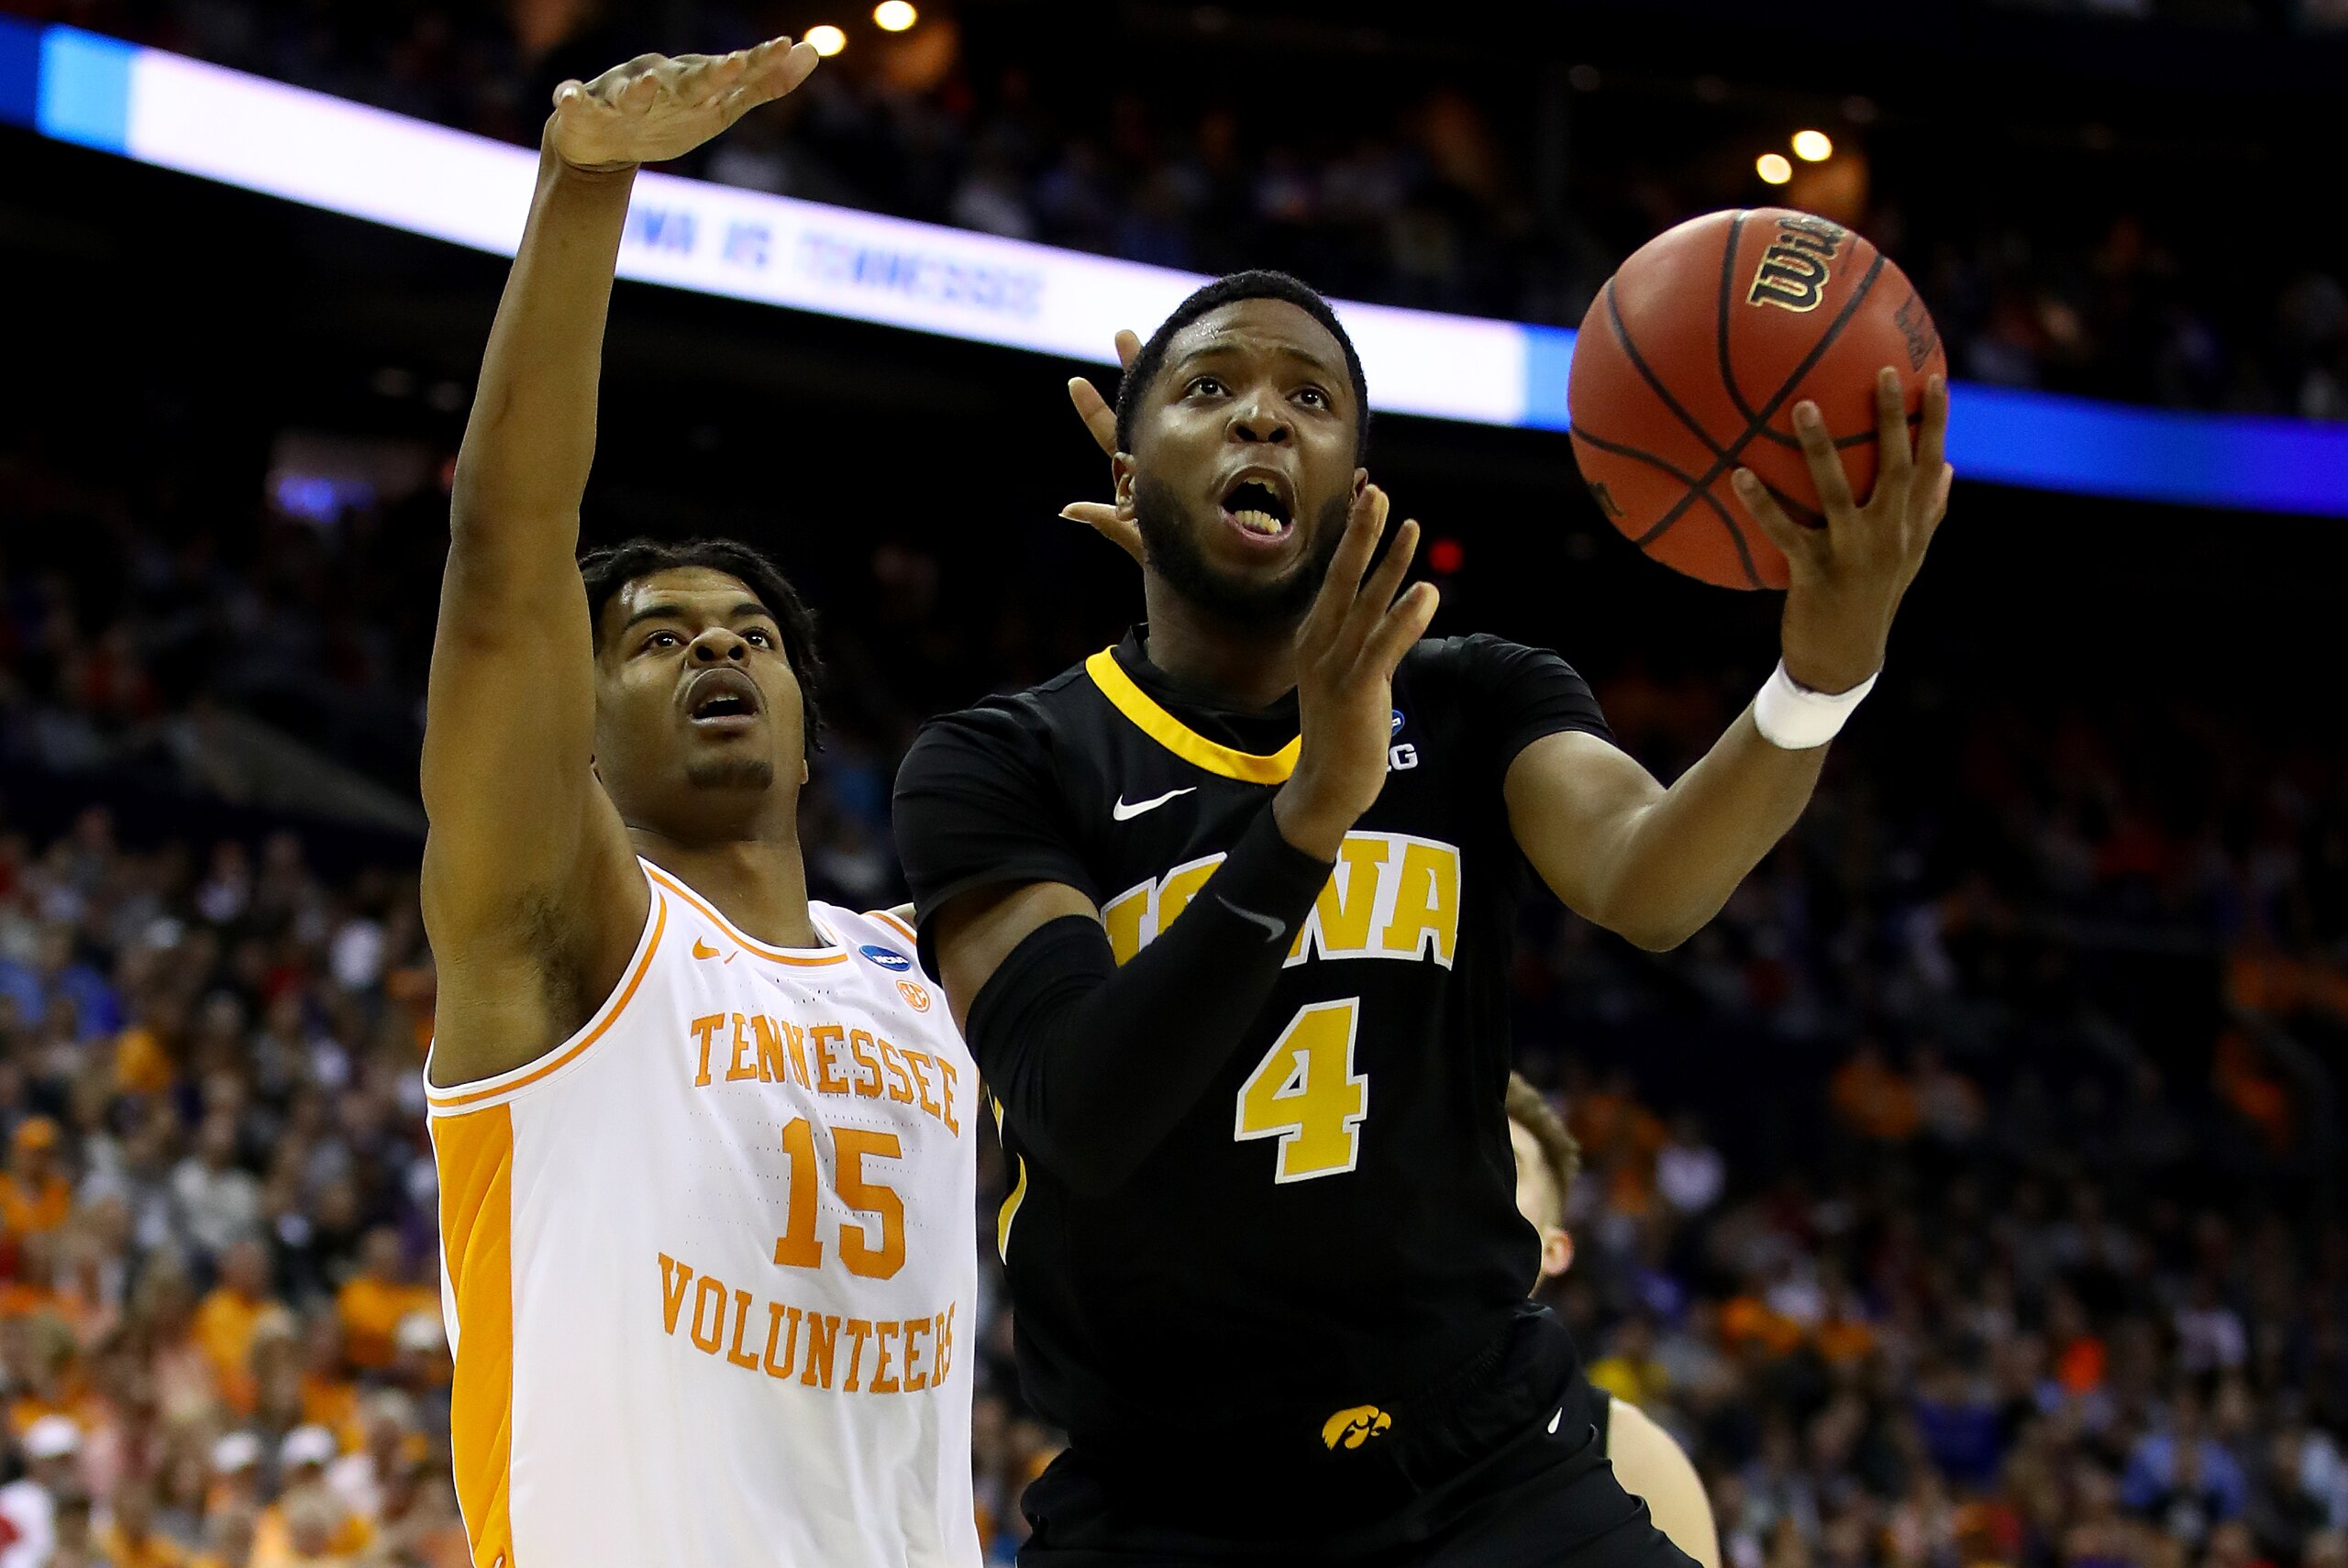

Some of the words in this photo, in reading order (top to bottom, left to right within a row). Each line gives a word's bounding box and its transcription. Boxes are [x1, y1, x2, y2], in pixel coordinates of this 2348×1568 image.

[691, 1011, 959, 1138] TENNESSEE
[1235, 997, 1368, 1184] 4
[774, 1117, 906, 1280] 15
[658, 1252, 956, 1394] VOLUNTEERS
